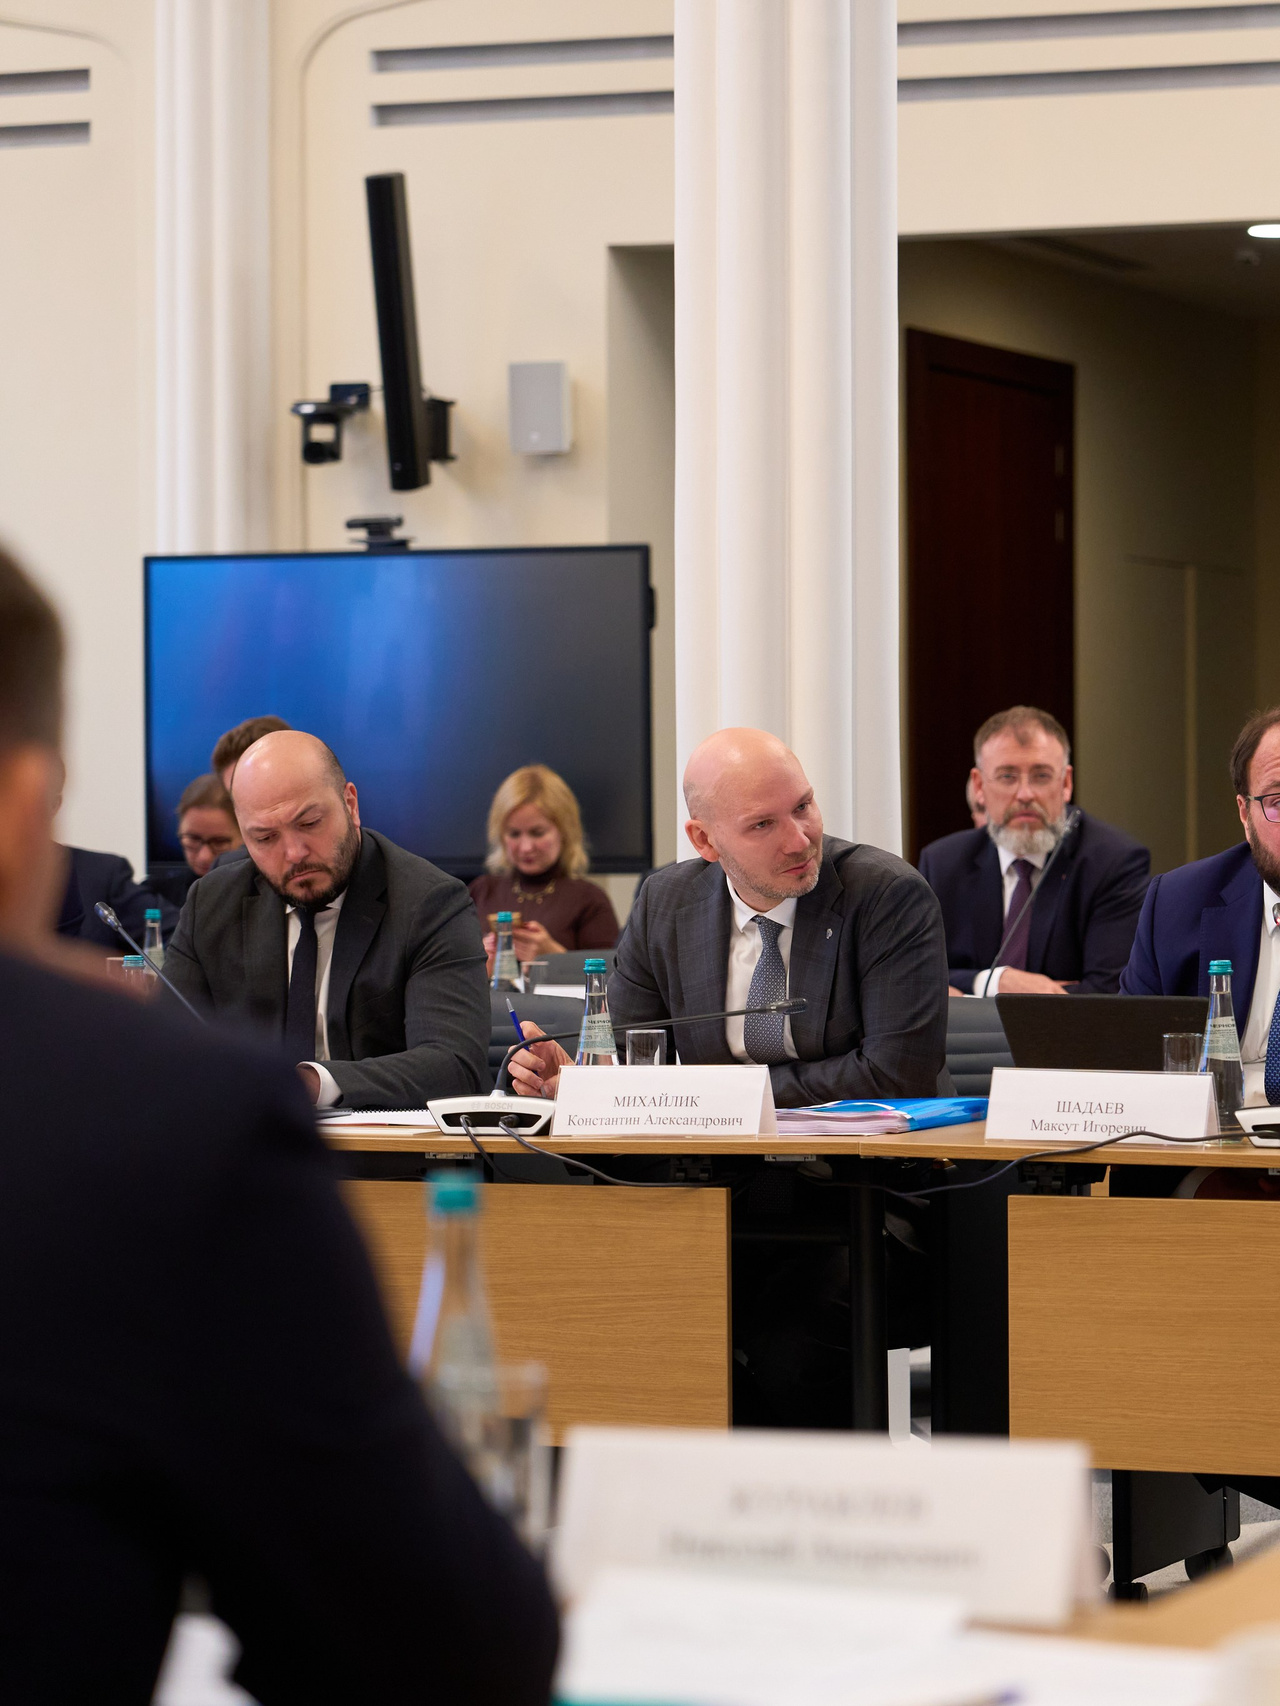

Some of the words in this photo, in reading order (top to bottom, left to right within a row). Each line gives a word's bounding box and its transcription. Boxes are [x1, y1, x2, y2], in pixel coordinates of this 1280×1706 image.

[484, 1102, 514, 1110] BOSCH
[613, 1093, 701, 1108] МИХАЙЛИК
[1056, 1100, 1125, 1115] ШАДАЕВ
[567, 1114, 640, 1127] Константин
[644, 1113, 743, 1129] Александрович
[1030, 1119, 1080, 1135] Максут
